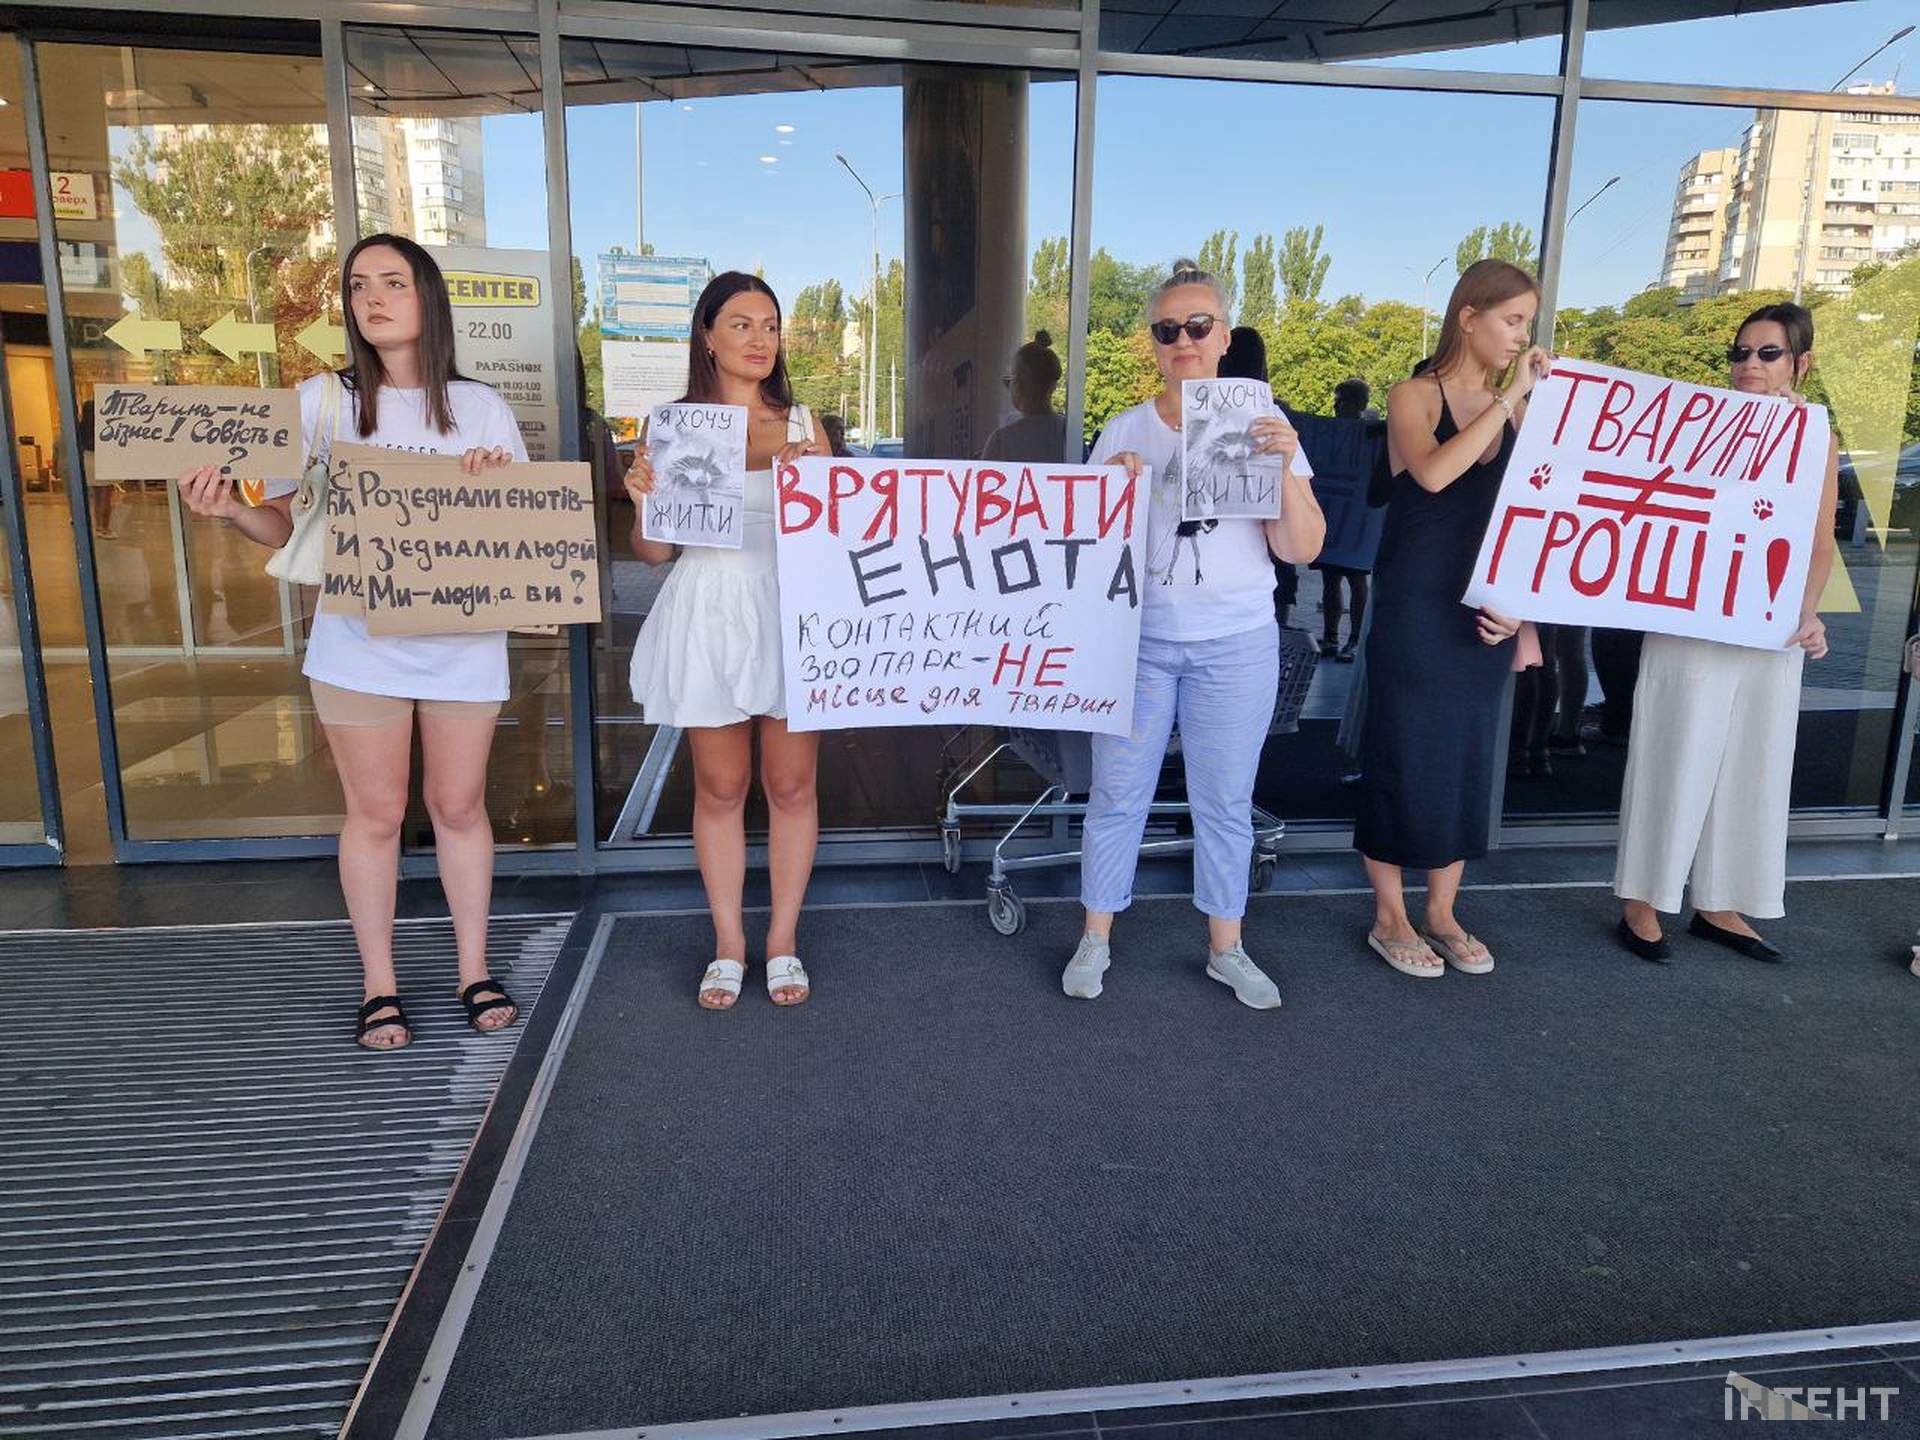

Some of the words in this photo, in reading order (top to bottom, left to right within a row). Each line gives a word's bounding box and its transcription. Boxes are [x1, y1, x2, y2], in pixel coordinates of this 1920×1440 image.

[57, 176, 71, 195] 2
[468, 321, 512, 340] 22.00
[1190, 384, 1209, 410] Я
[657, 408, 671, 427] Я
[675, 408, 733, 430] ХОЧУ
[1551, 368, 1807, 483] ТВАРИНИ
[776, 465, 1137, 541] ВРЯТУВАТИ
[1186, 474, 1275, 507] ЖИТИ
[652, 501, 733, 534] ЖИТИ
[848, 532, 1138, 609] ЕНОТА
[526, 584, 562, 603] ви
[799, 602, 1064, 650] КОНТАКТНИЙ
[992, 642, 1075, 686] НЕ
